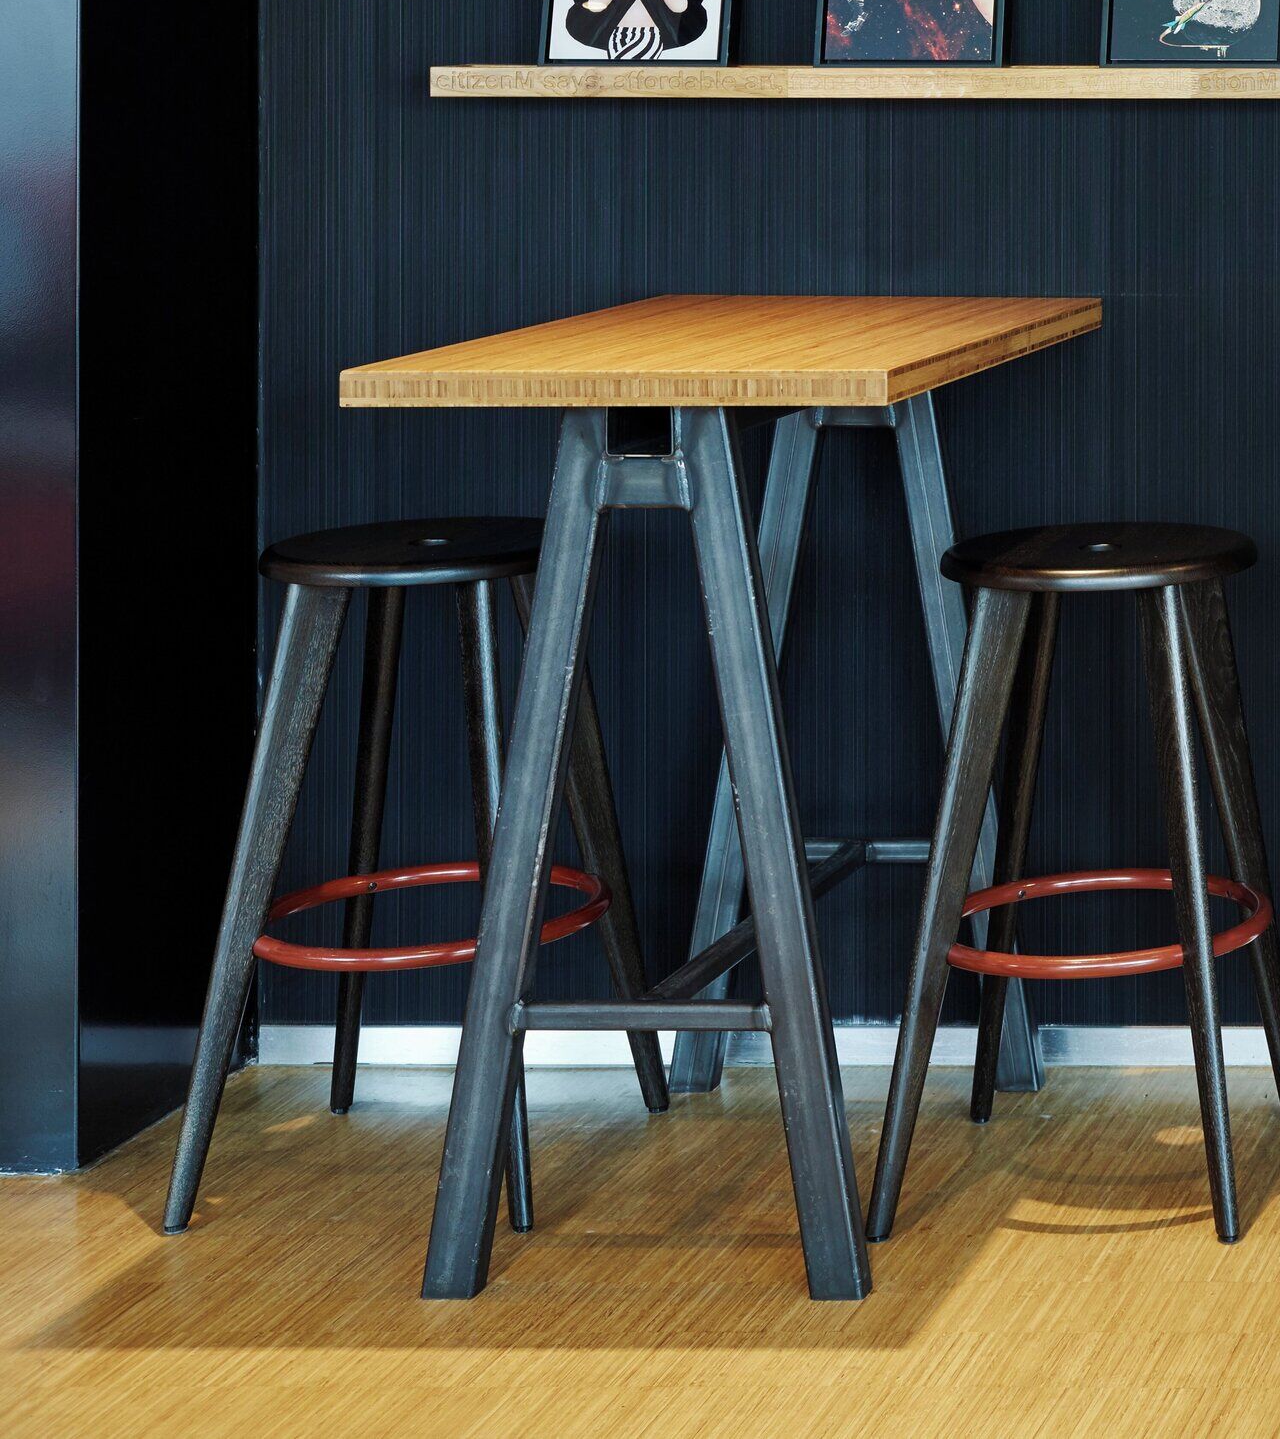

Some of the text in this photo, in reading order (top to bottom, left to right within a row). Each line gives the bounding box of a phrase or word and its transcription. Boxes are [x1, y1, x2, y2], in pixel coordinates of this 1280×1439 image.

[435, 70, 534, 90] citizenM
[543, 74, 605, 95] says:
[613, 70, 737, 91] affordable
[744, 73, 783, 94] art,
[791, 70, 846, 91] from
[854, 76, 892, 91] our
[971, 74, 992, 90] to
[1002, 76, 1074, 96] yours,
[1082, 73, 1131, 91] with
[1141, 72, 1277, 91] collectionM
